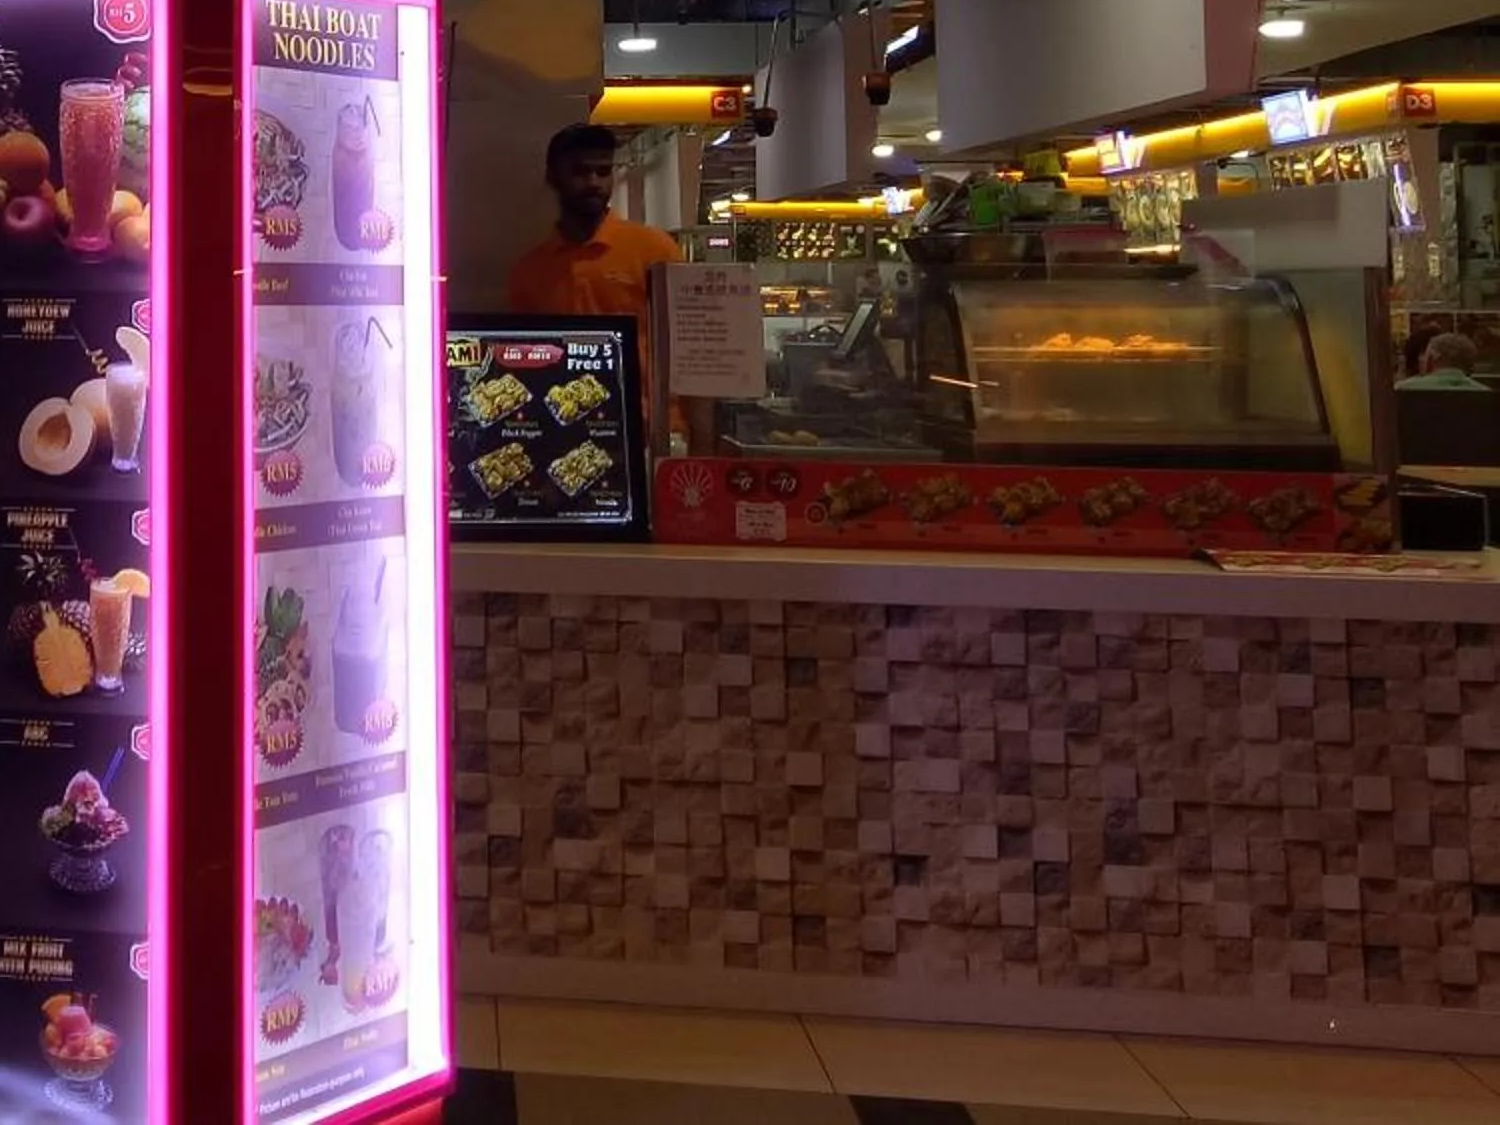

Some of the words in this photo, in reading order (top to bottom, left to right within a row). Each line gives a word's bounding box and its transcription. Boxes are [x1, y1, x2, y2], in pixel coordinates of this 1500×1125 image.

[326, 7, 382, 41] BOAT
[273, 31, 376, 71] NOODLES
[713, 93, 737, 111] C3
[1406, 93, 1433, 110] D3
[7, 304, 71, 318] HONEYDEW
[21, 319, 55, 334] JUICE
[567, 342, 598, 358] Buy
[603, 343, 613, 356] 5
[567, 358, 601, 370] Free
[606, 359, 613, 370] 1
[7, 511, 69, 527] PINEAPPLE
[21, 528, 55, 543] JUICE
